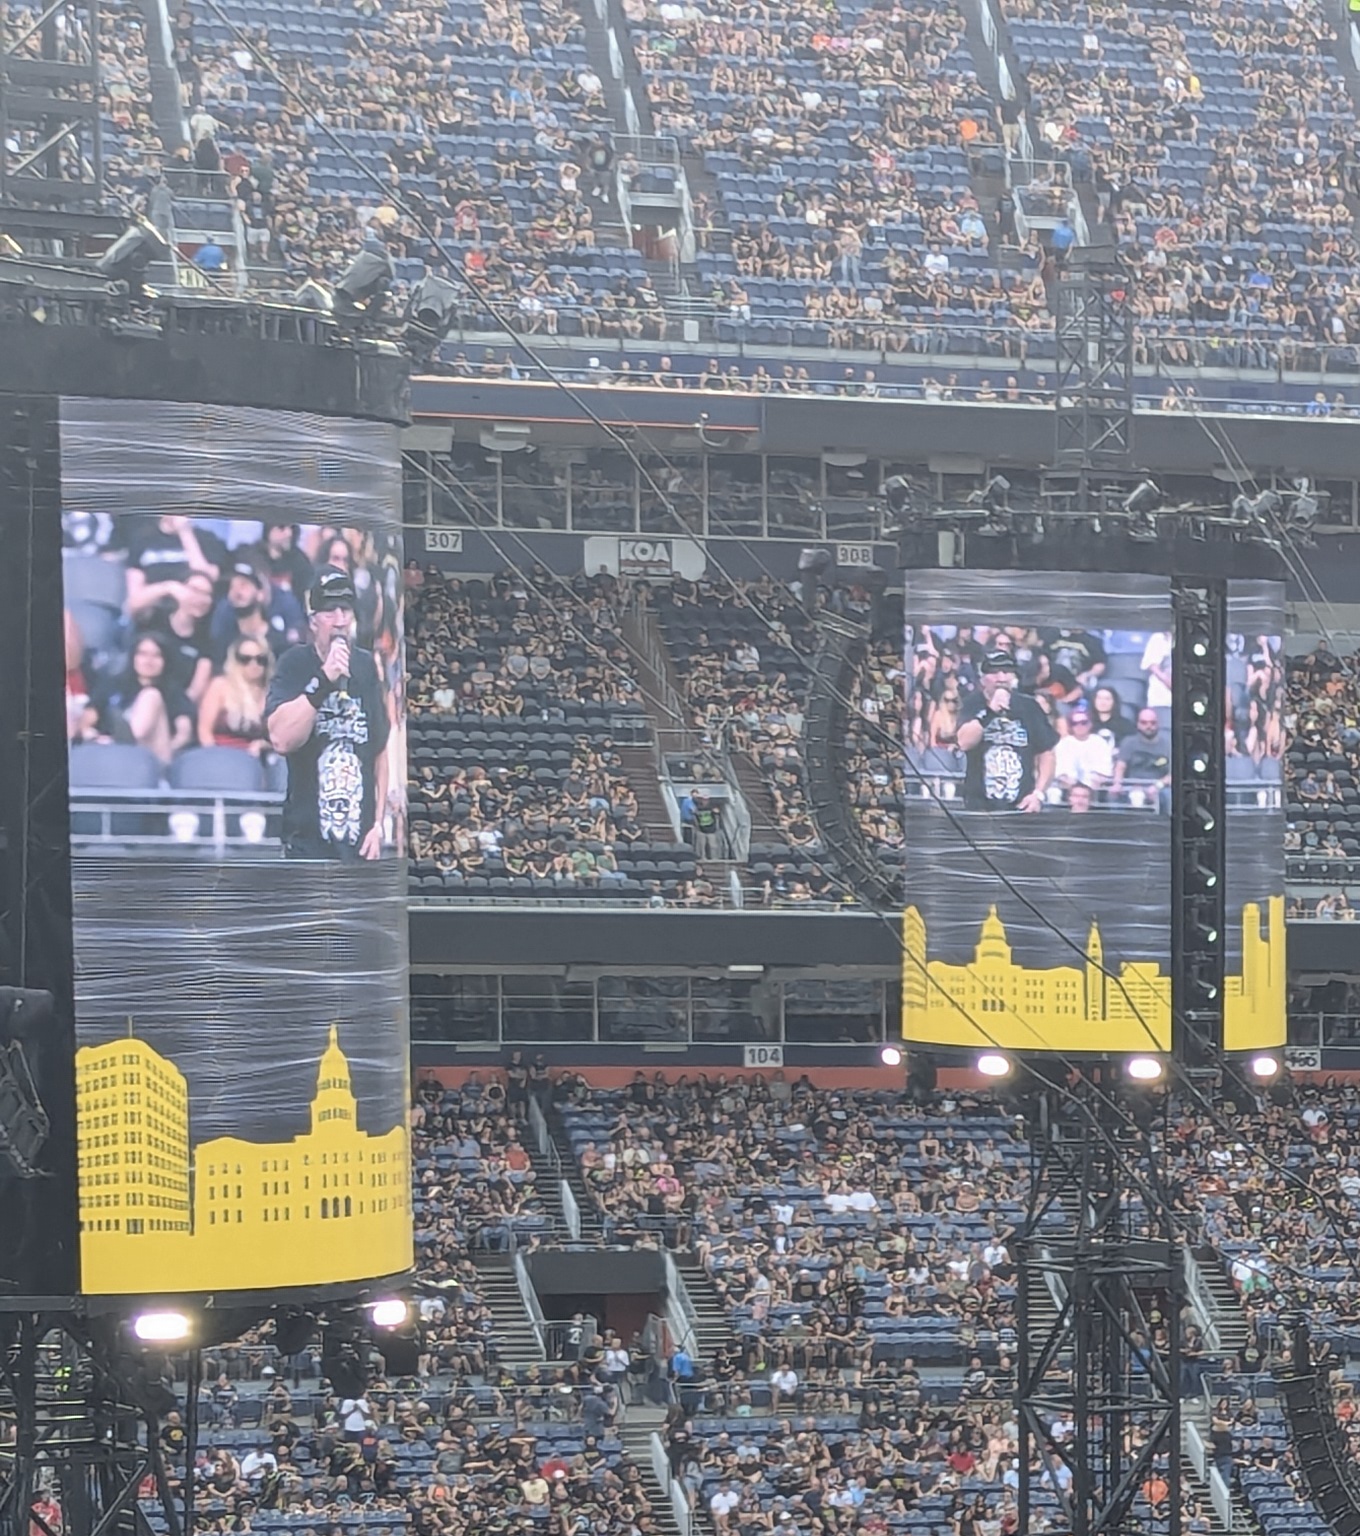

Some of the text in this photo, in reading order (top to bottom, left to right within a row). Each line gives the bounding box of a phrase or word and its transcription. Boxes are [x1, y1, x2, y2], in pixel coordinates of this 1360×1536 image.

[428, 532, 461, 549] 307
[620, 541, 672, 562] KOA
[748, 1048, 780, 1064] 104
